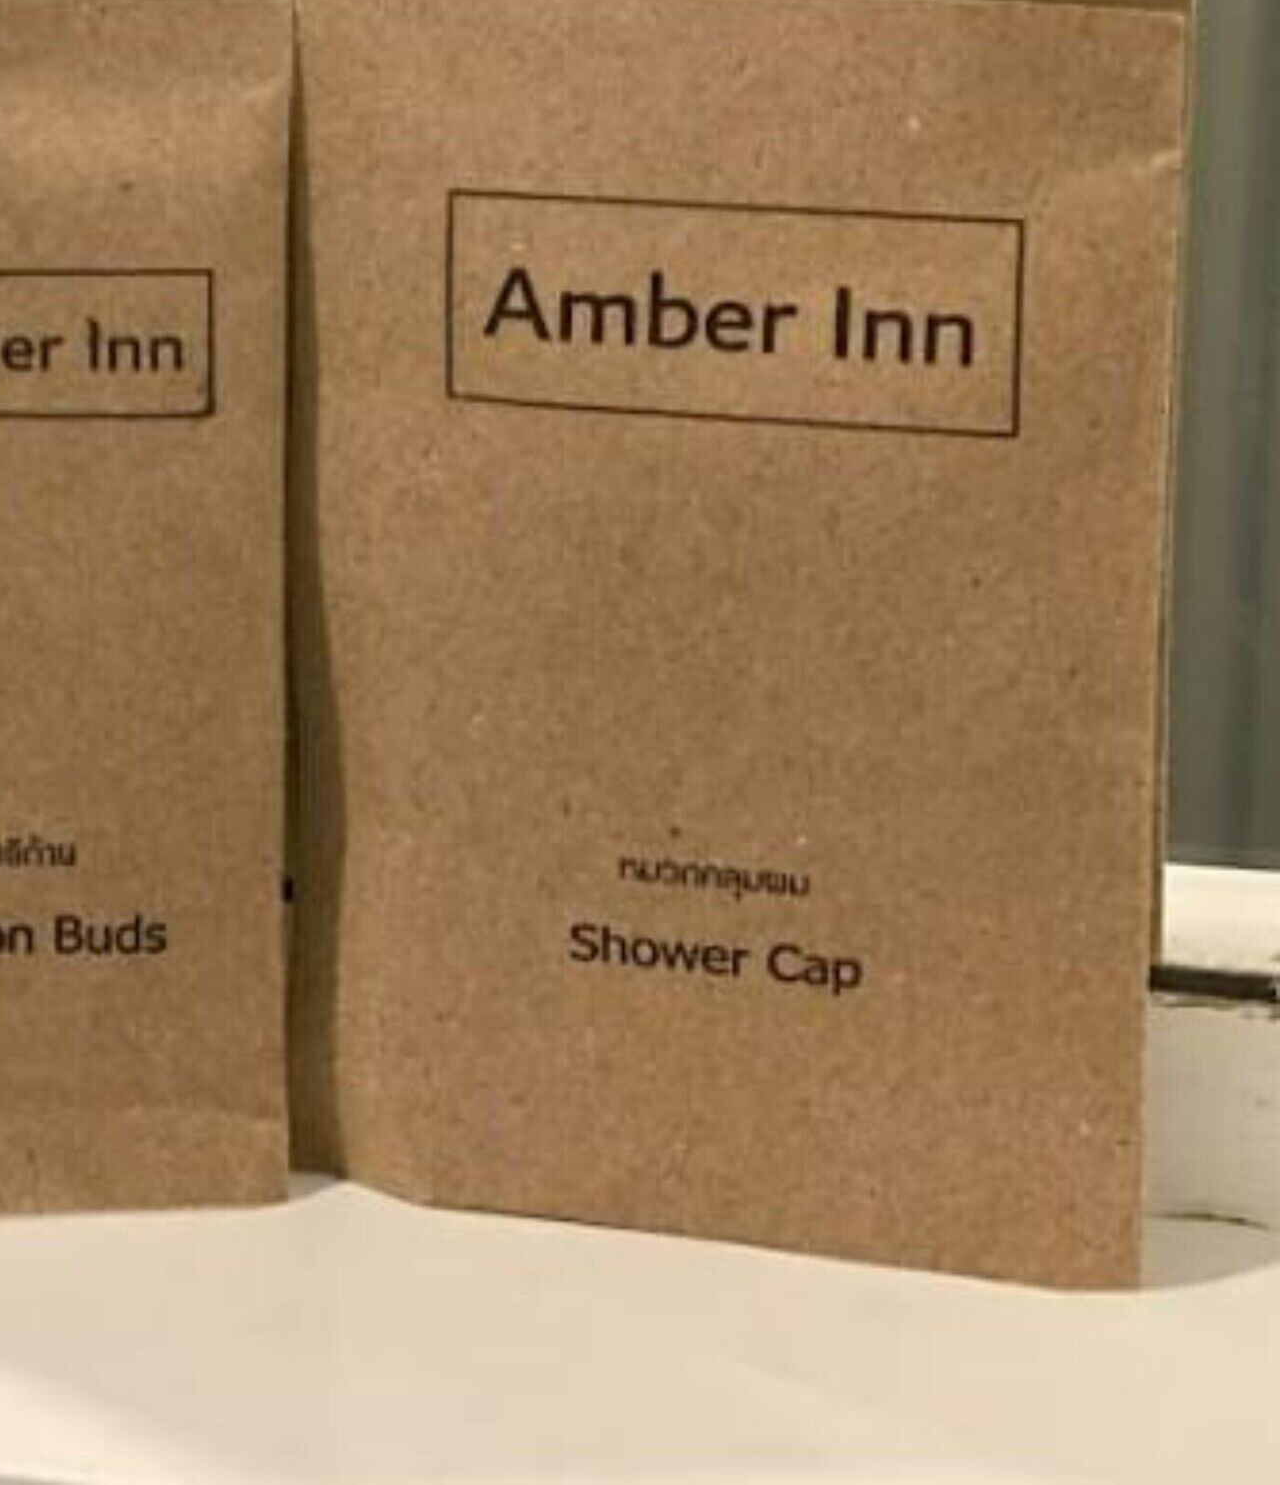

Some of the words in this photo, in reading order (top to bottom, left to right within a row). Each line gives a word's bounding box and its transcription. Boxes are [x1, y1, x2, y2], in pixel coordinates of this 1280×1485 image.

[88, 317, 185, 373] Inn
[483, 266, 798, 355] Amber
[833, 284, 974, 367] Inn
[52, 912, 169, 956] Buds
[568, 922, 750, 977] Shower
[766, 942, 862, 996] Cap
